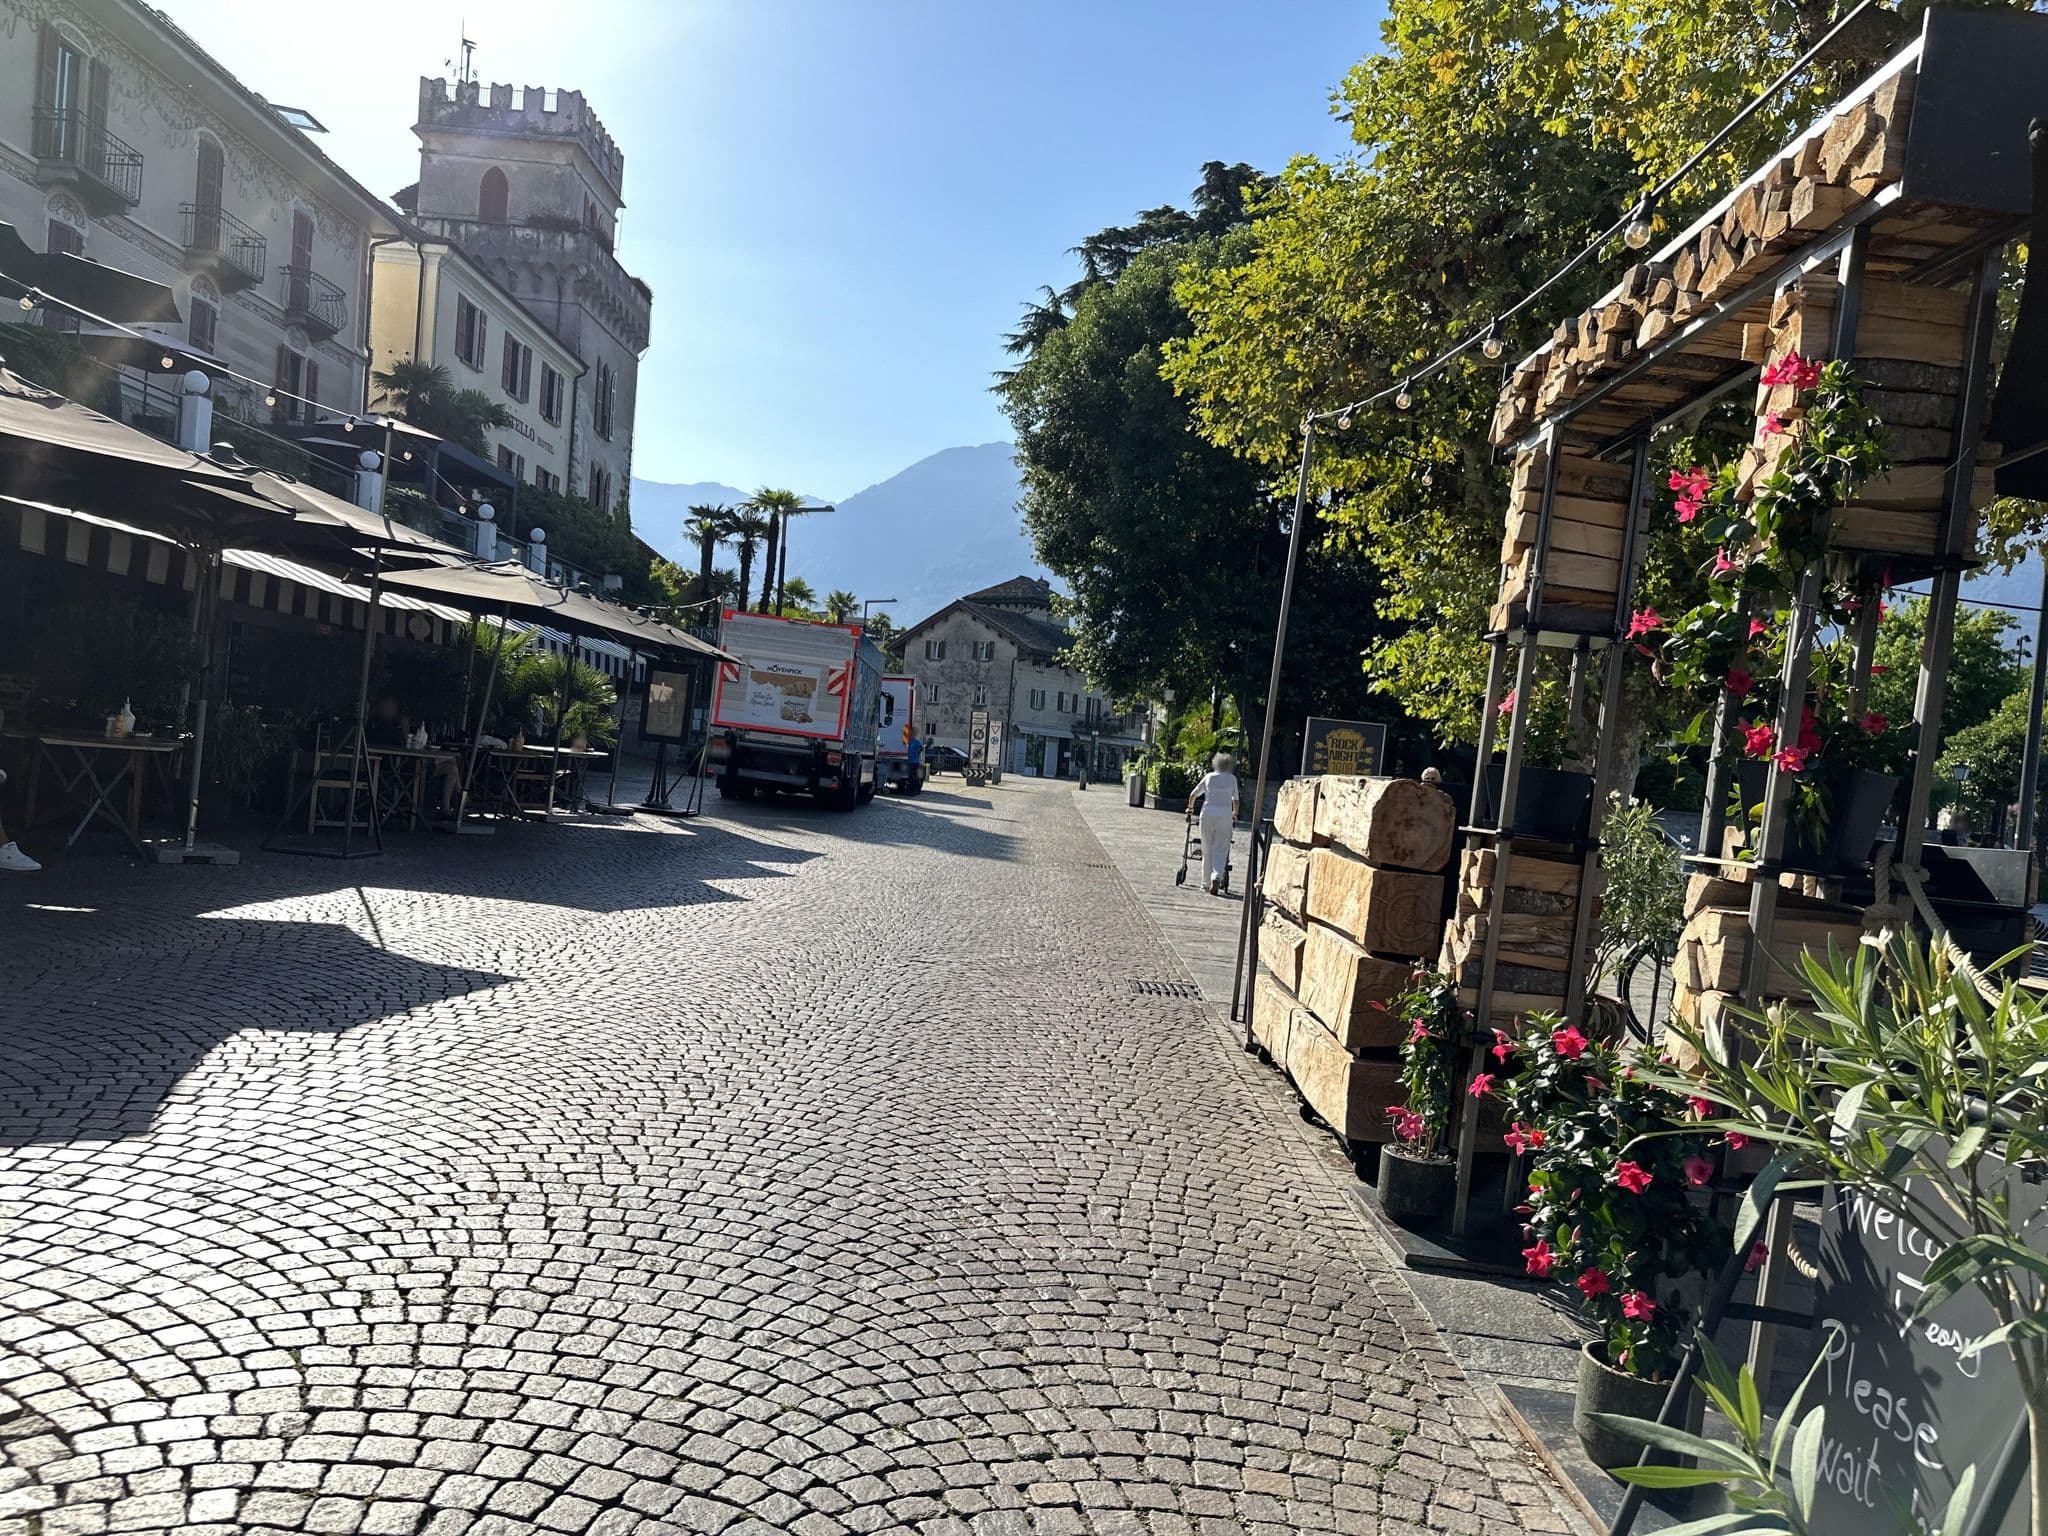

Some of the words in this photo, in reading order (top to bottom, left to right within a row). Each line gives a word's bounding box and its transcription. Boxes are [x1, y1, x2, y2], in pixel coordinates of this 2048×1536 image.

[1331, 738, 1358, 752] ROCK
[1328, 749, 1359, 762] NIGHT
[1822, 1318, 1943, 1470] Please
